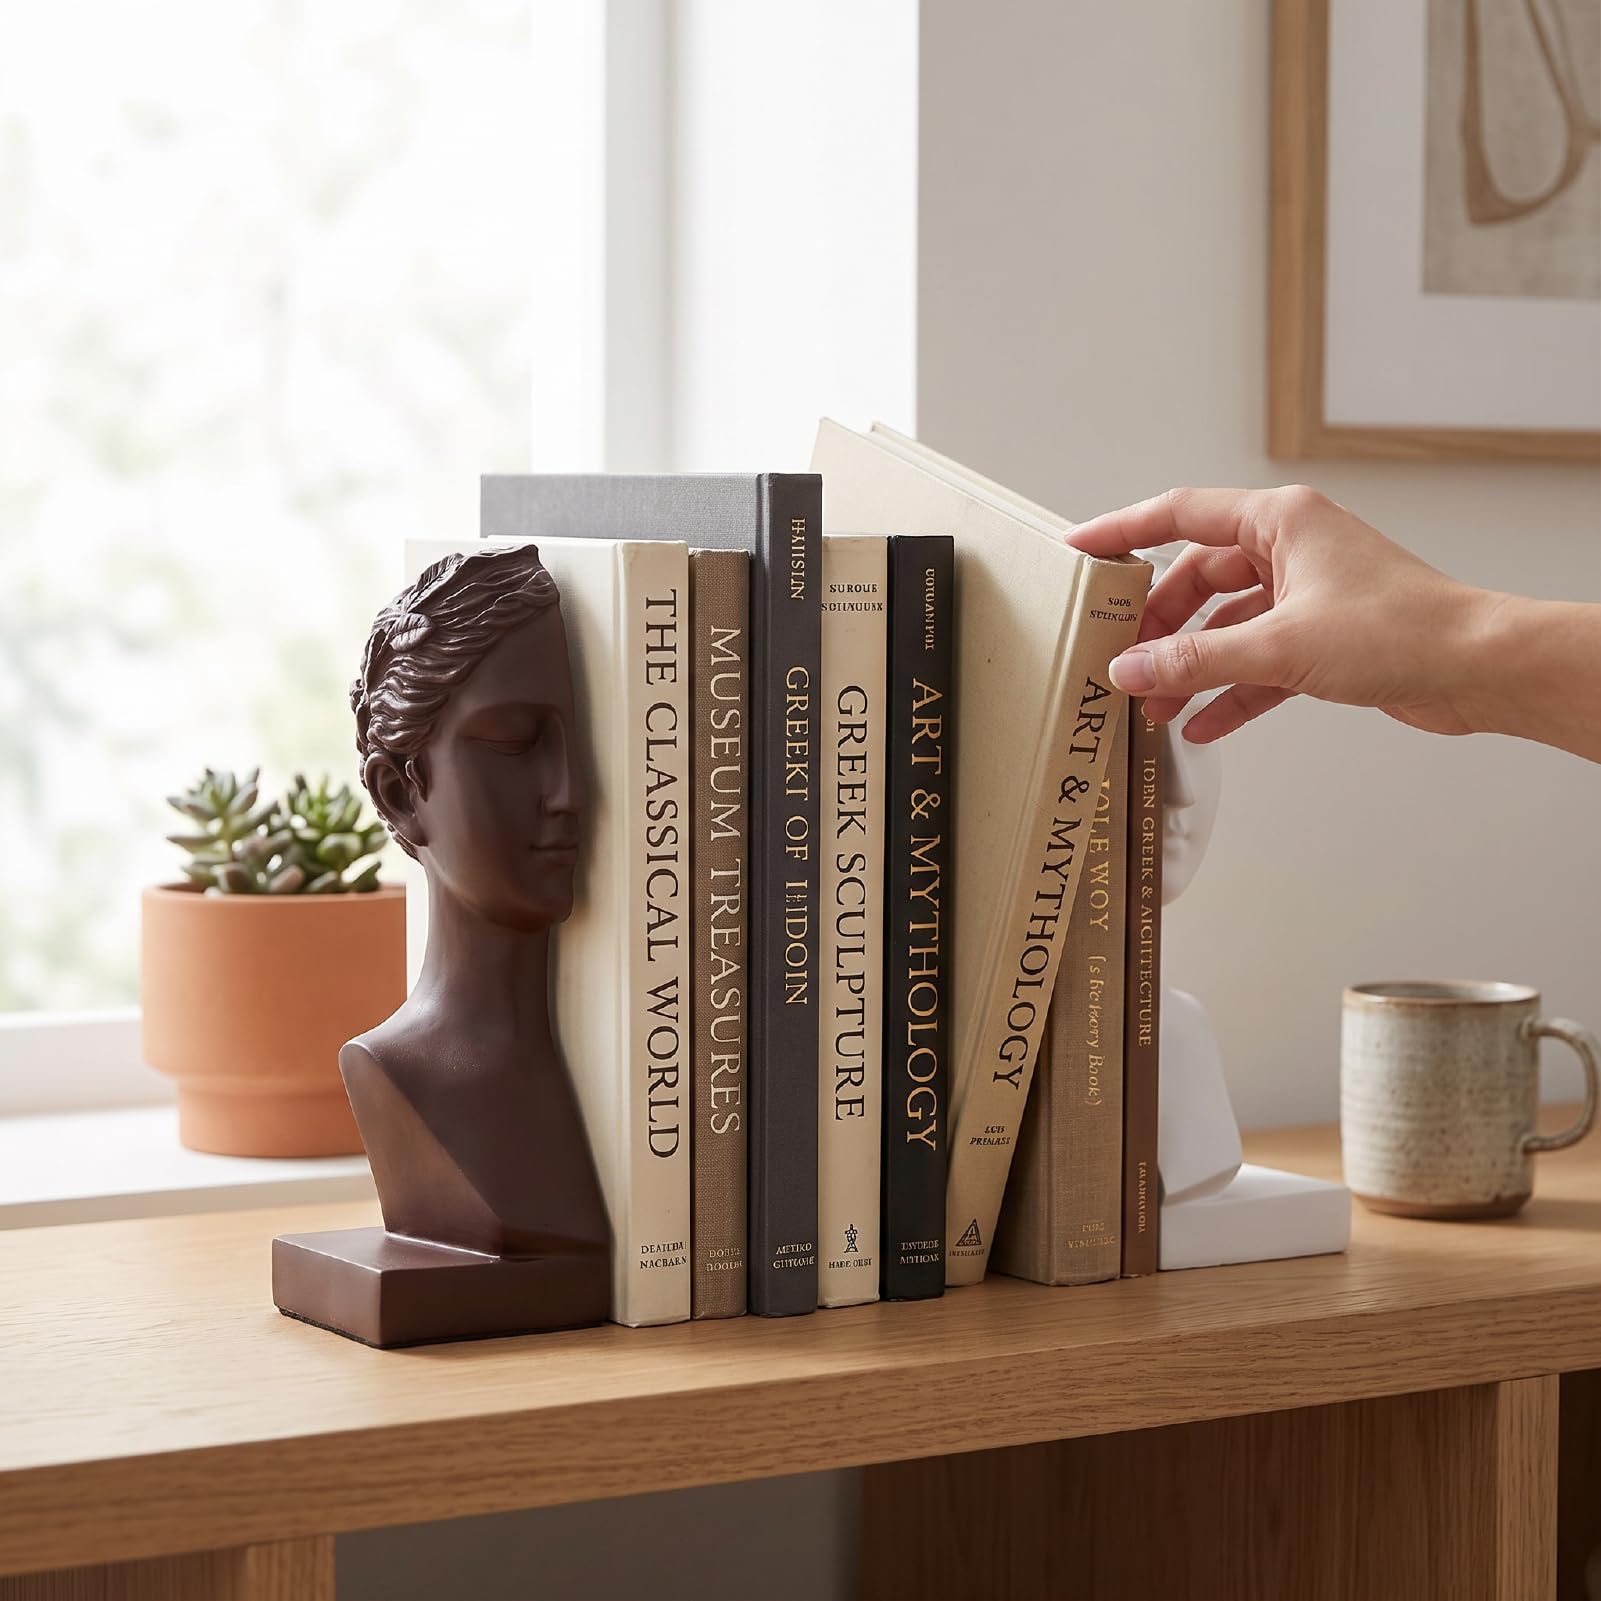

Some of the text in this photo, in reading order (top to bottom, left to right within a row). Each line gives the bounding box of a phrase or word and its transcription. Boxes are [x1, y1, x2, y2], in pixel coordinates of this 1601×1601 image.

[645, 588, 680, 1158] THE CLASSICAL WORLD
[709, 625, 742, 1135] MUSEUM TREASURES
[785, 814, 809, 861] OF
[835, 685, 868, 1121] GREEK SCULPTURE
[906, 677, 944, 1152] ART & MYTHOLOGY
[992, 676, 1113, 1090] ART & MYTHOLOGY
[1140, 885, 1154, 899] &
[1141, 817, 1156, 881] GREEK
